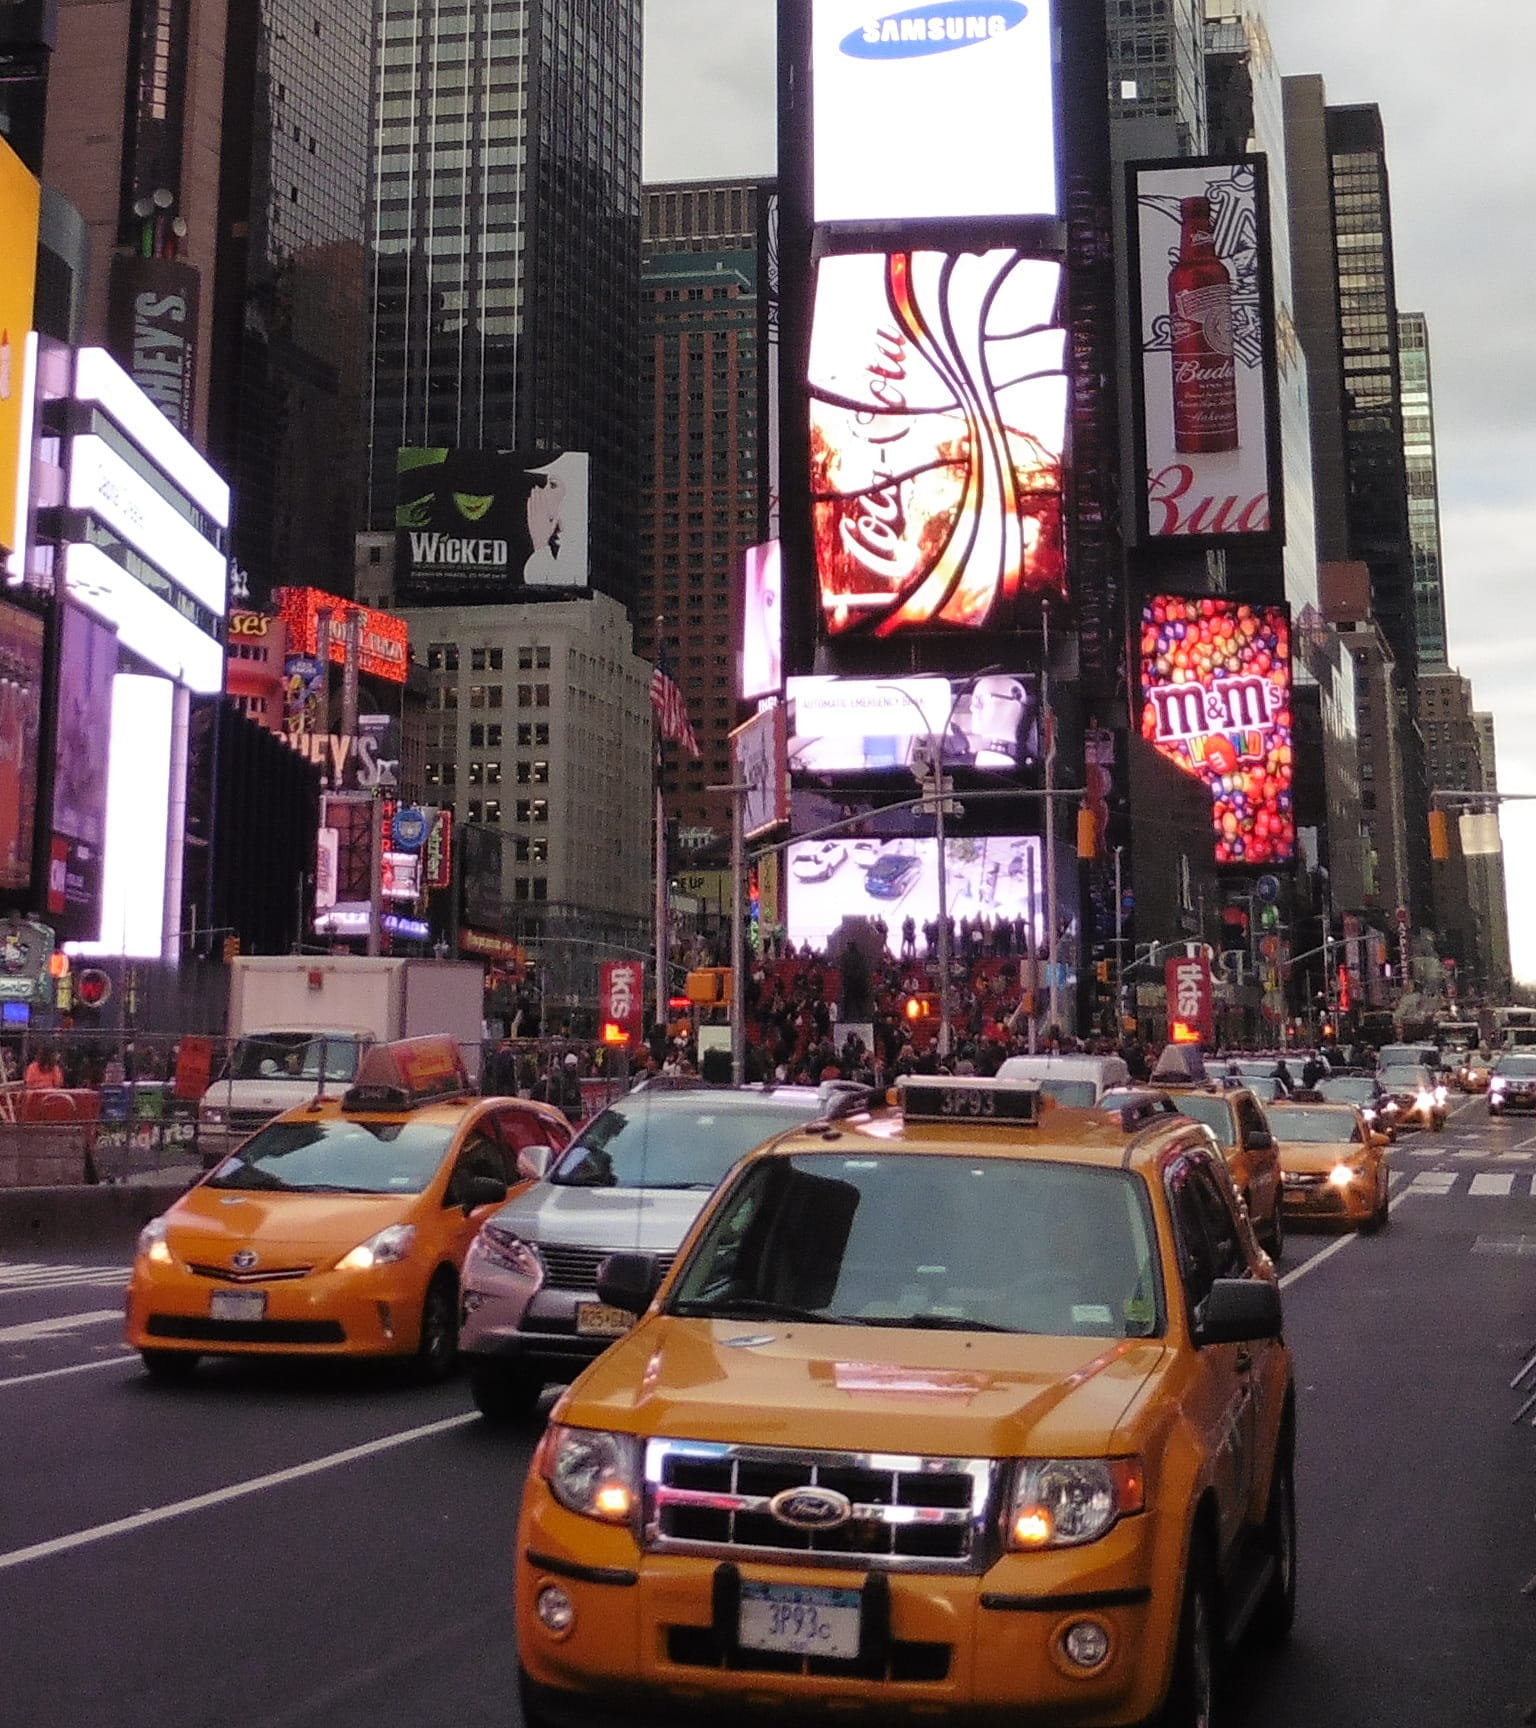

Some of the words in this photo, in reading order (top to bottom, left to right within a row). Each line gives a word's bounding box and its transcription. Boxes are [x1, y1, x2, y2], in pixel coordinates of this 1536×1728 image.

[862, 15, 1007, 43] SAMSUNG
[1190, 728, 1262, 764] WLD
[611, 966, 635, 1019] tkts
[1177, 963, 1203, 1017] tkts
[941, 1090, 996, 1116] 3P93
